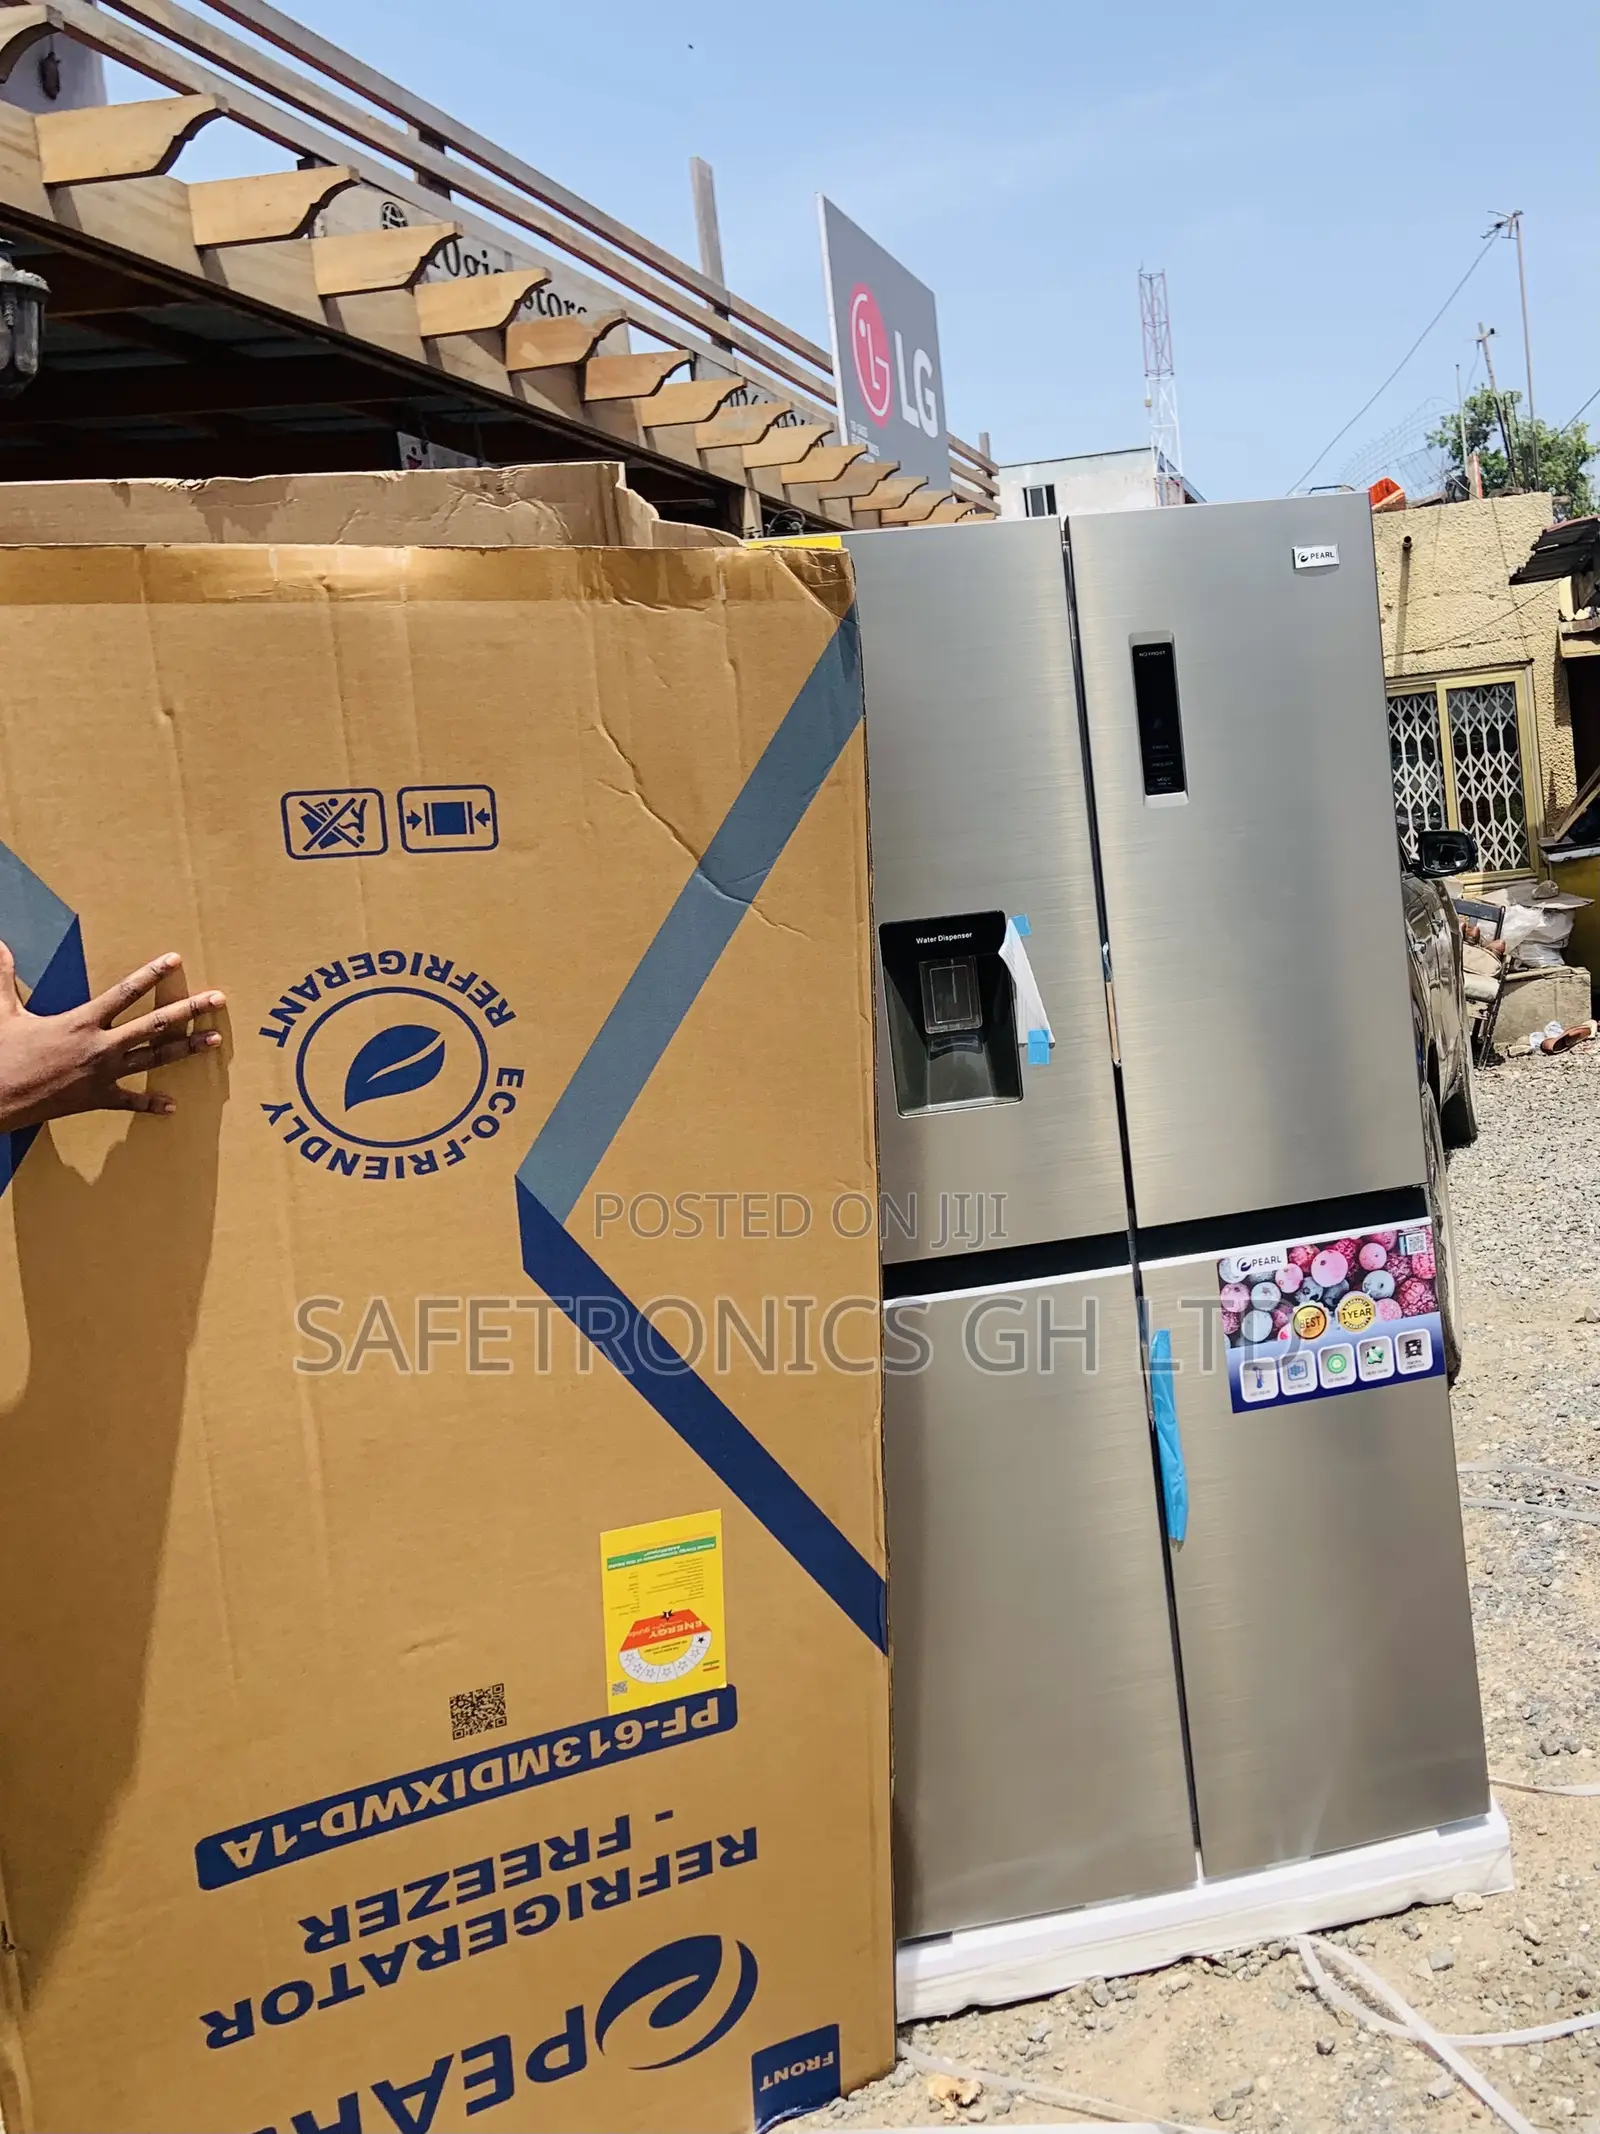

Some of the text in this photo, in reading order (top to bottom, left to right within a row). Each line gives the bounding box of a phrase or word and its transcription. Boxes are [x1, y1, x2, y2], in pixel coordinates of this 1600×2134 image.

[894, 330, 939, 438] LG
[1310, 551, 1335, 560] PEARL
[915, 932, 973, 945] Water Dispenser
[258, 950, 517, 1048] REFRIGERANT
[259, 1067, 525, 1180] ECO-FRIENDLY
[1252, 1256, 1282, 1267] PEARL
[1300, 1315, 1321, 1329] BEST
[1347, 1307, 1372, 1318] YEAR
[648, 1620, 702, 1639] ENERGY
[221, 1695, 719, 1870] PF-613MDIXWD-1A
[298, 1812, 633, 1954] FREEZER
[200, 1827, 758, 2049] REFRIGERATOR
[759, 2051, 835, 2092] FRONT
